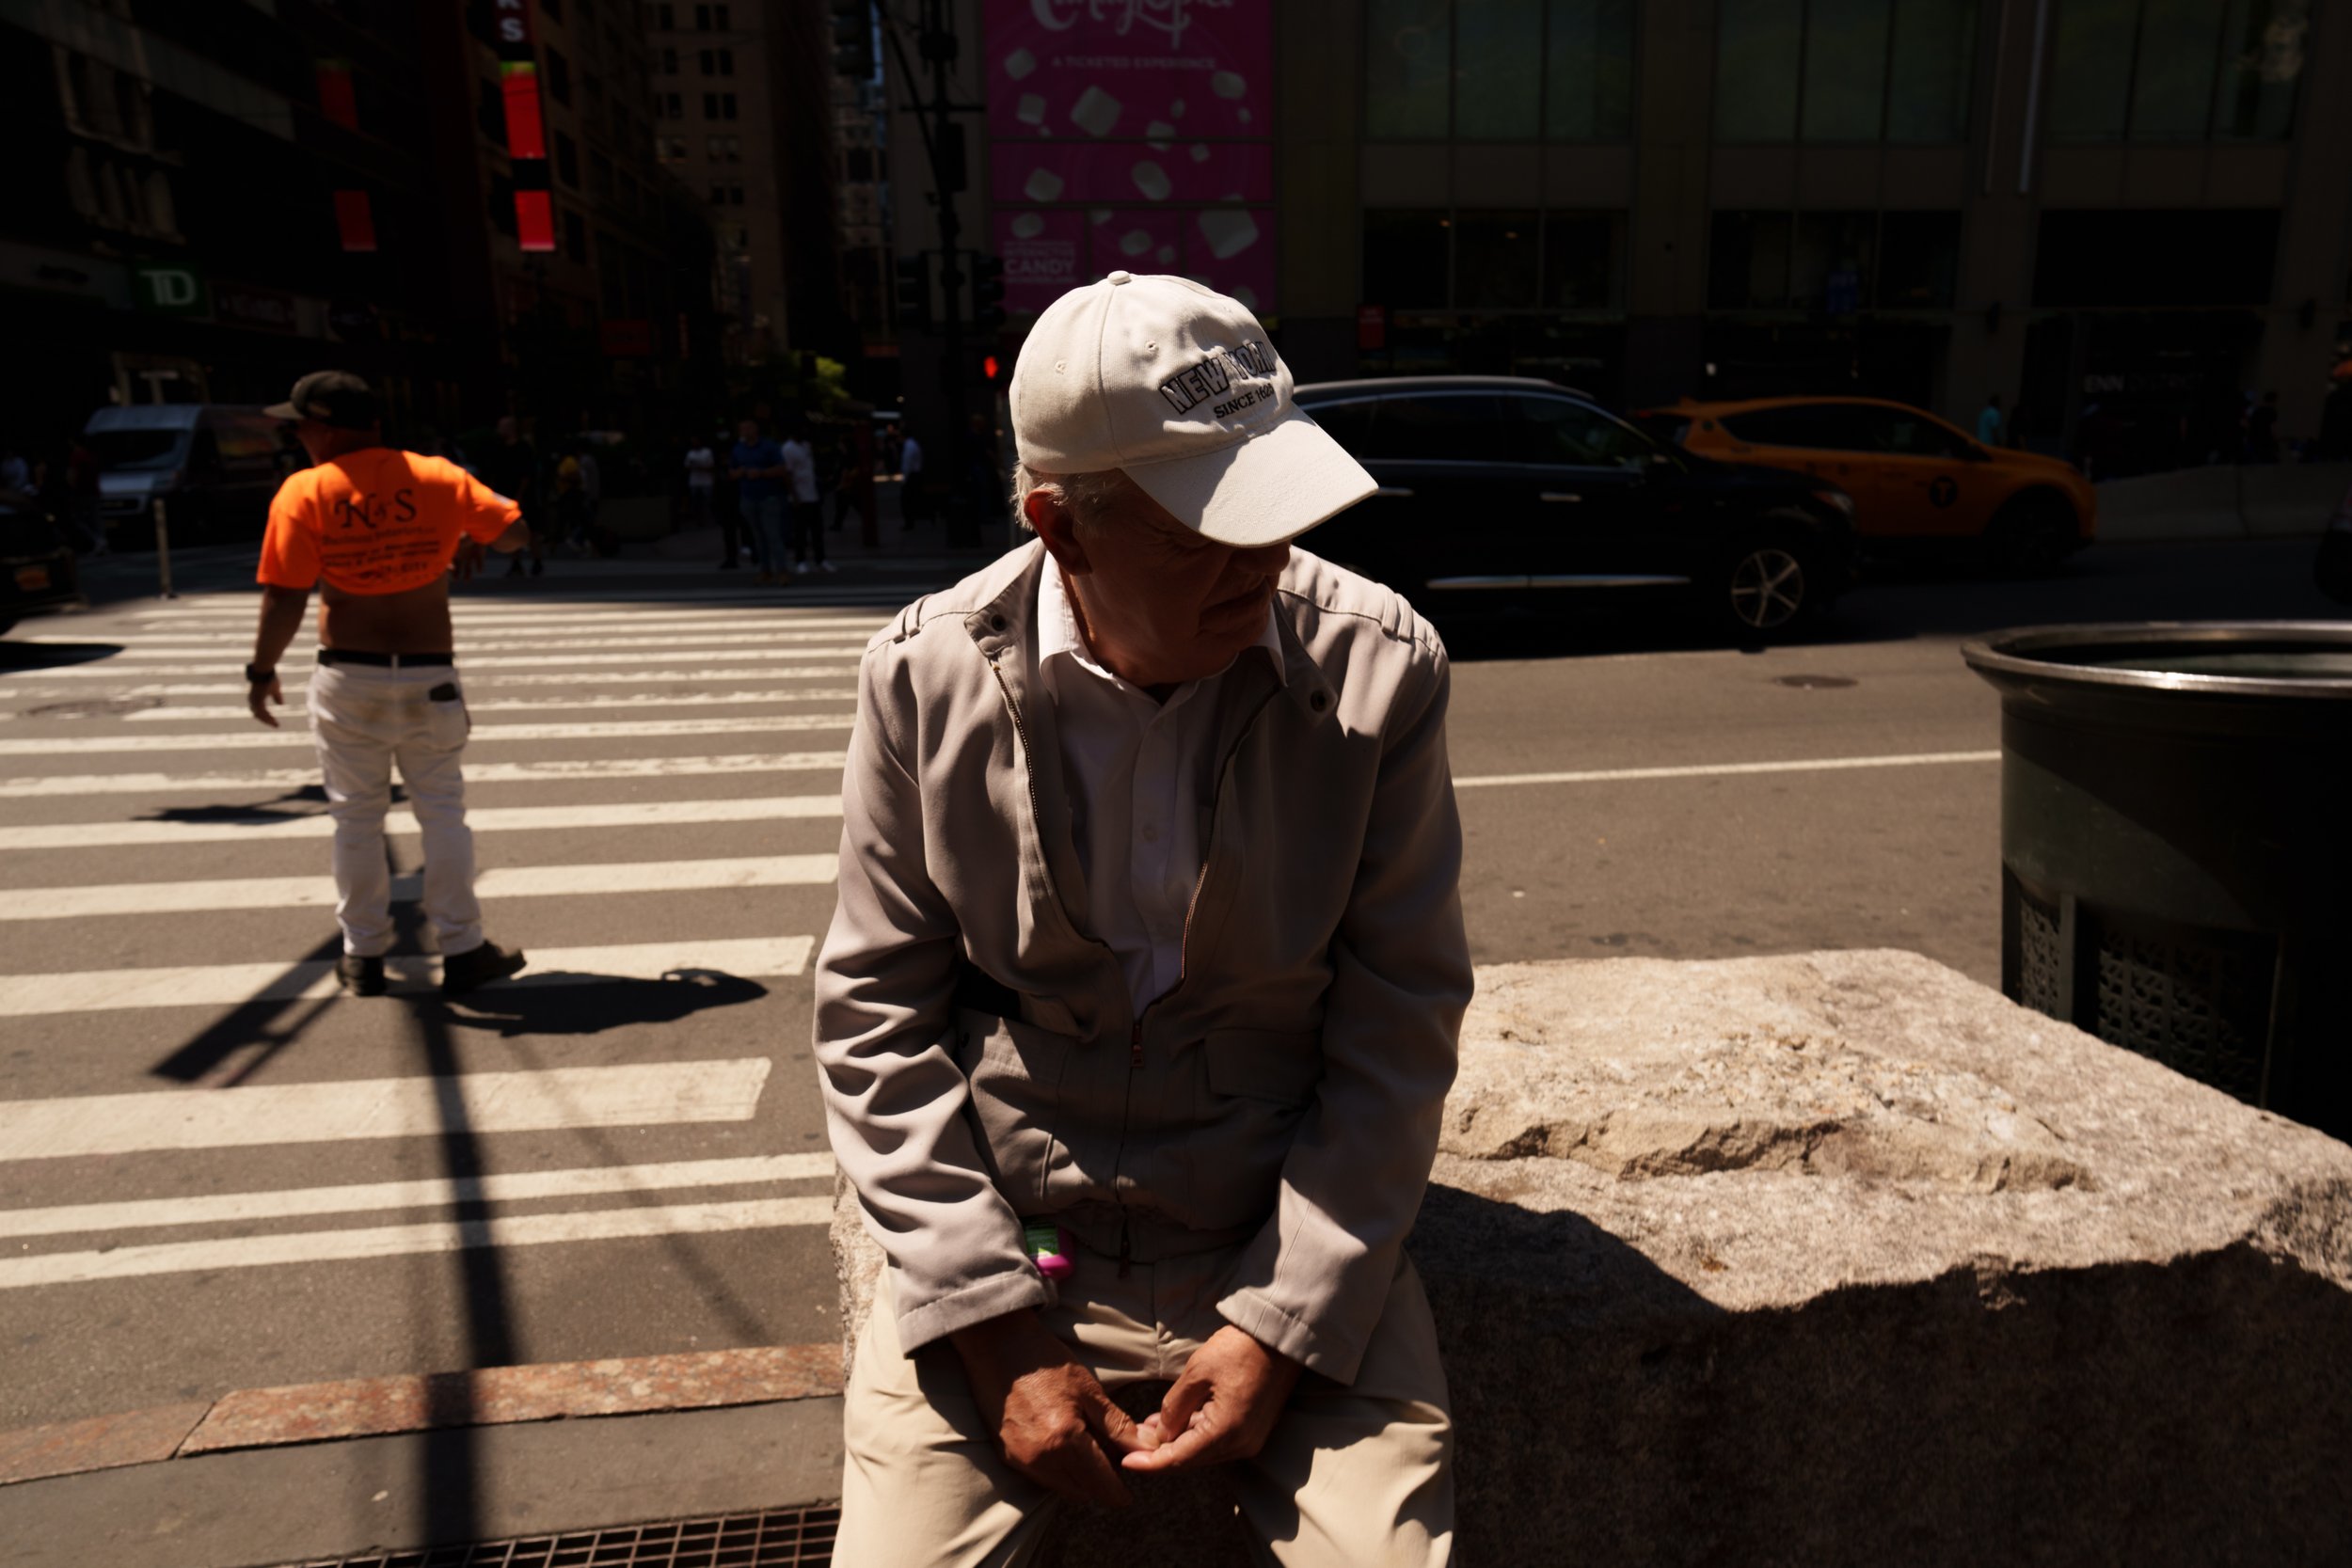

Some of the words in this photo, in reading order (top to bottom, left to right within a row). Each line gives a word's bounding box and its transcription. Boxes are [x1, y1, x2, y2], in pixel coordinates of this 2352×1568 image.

[1065, 55, 1130, 69] TICKETED
[1134, 56, 1216, 70] EXPERIENCE
[1003, 258, 1075, 275] CANDY
[138, 268, 199, 308] TD
[1159, 356, 1230, 415] NEW
[2083, 373, 2124, 393] ENN
[1214, 392, 1255, 419] SINCE
